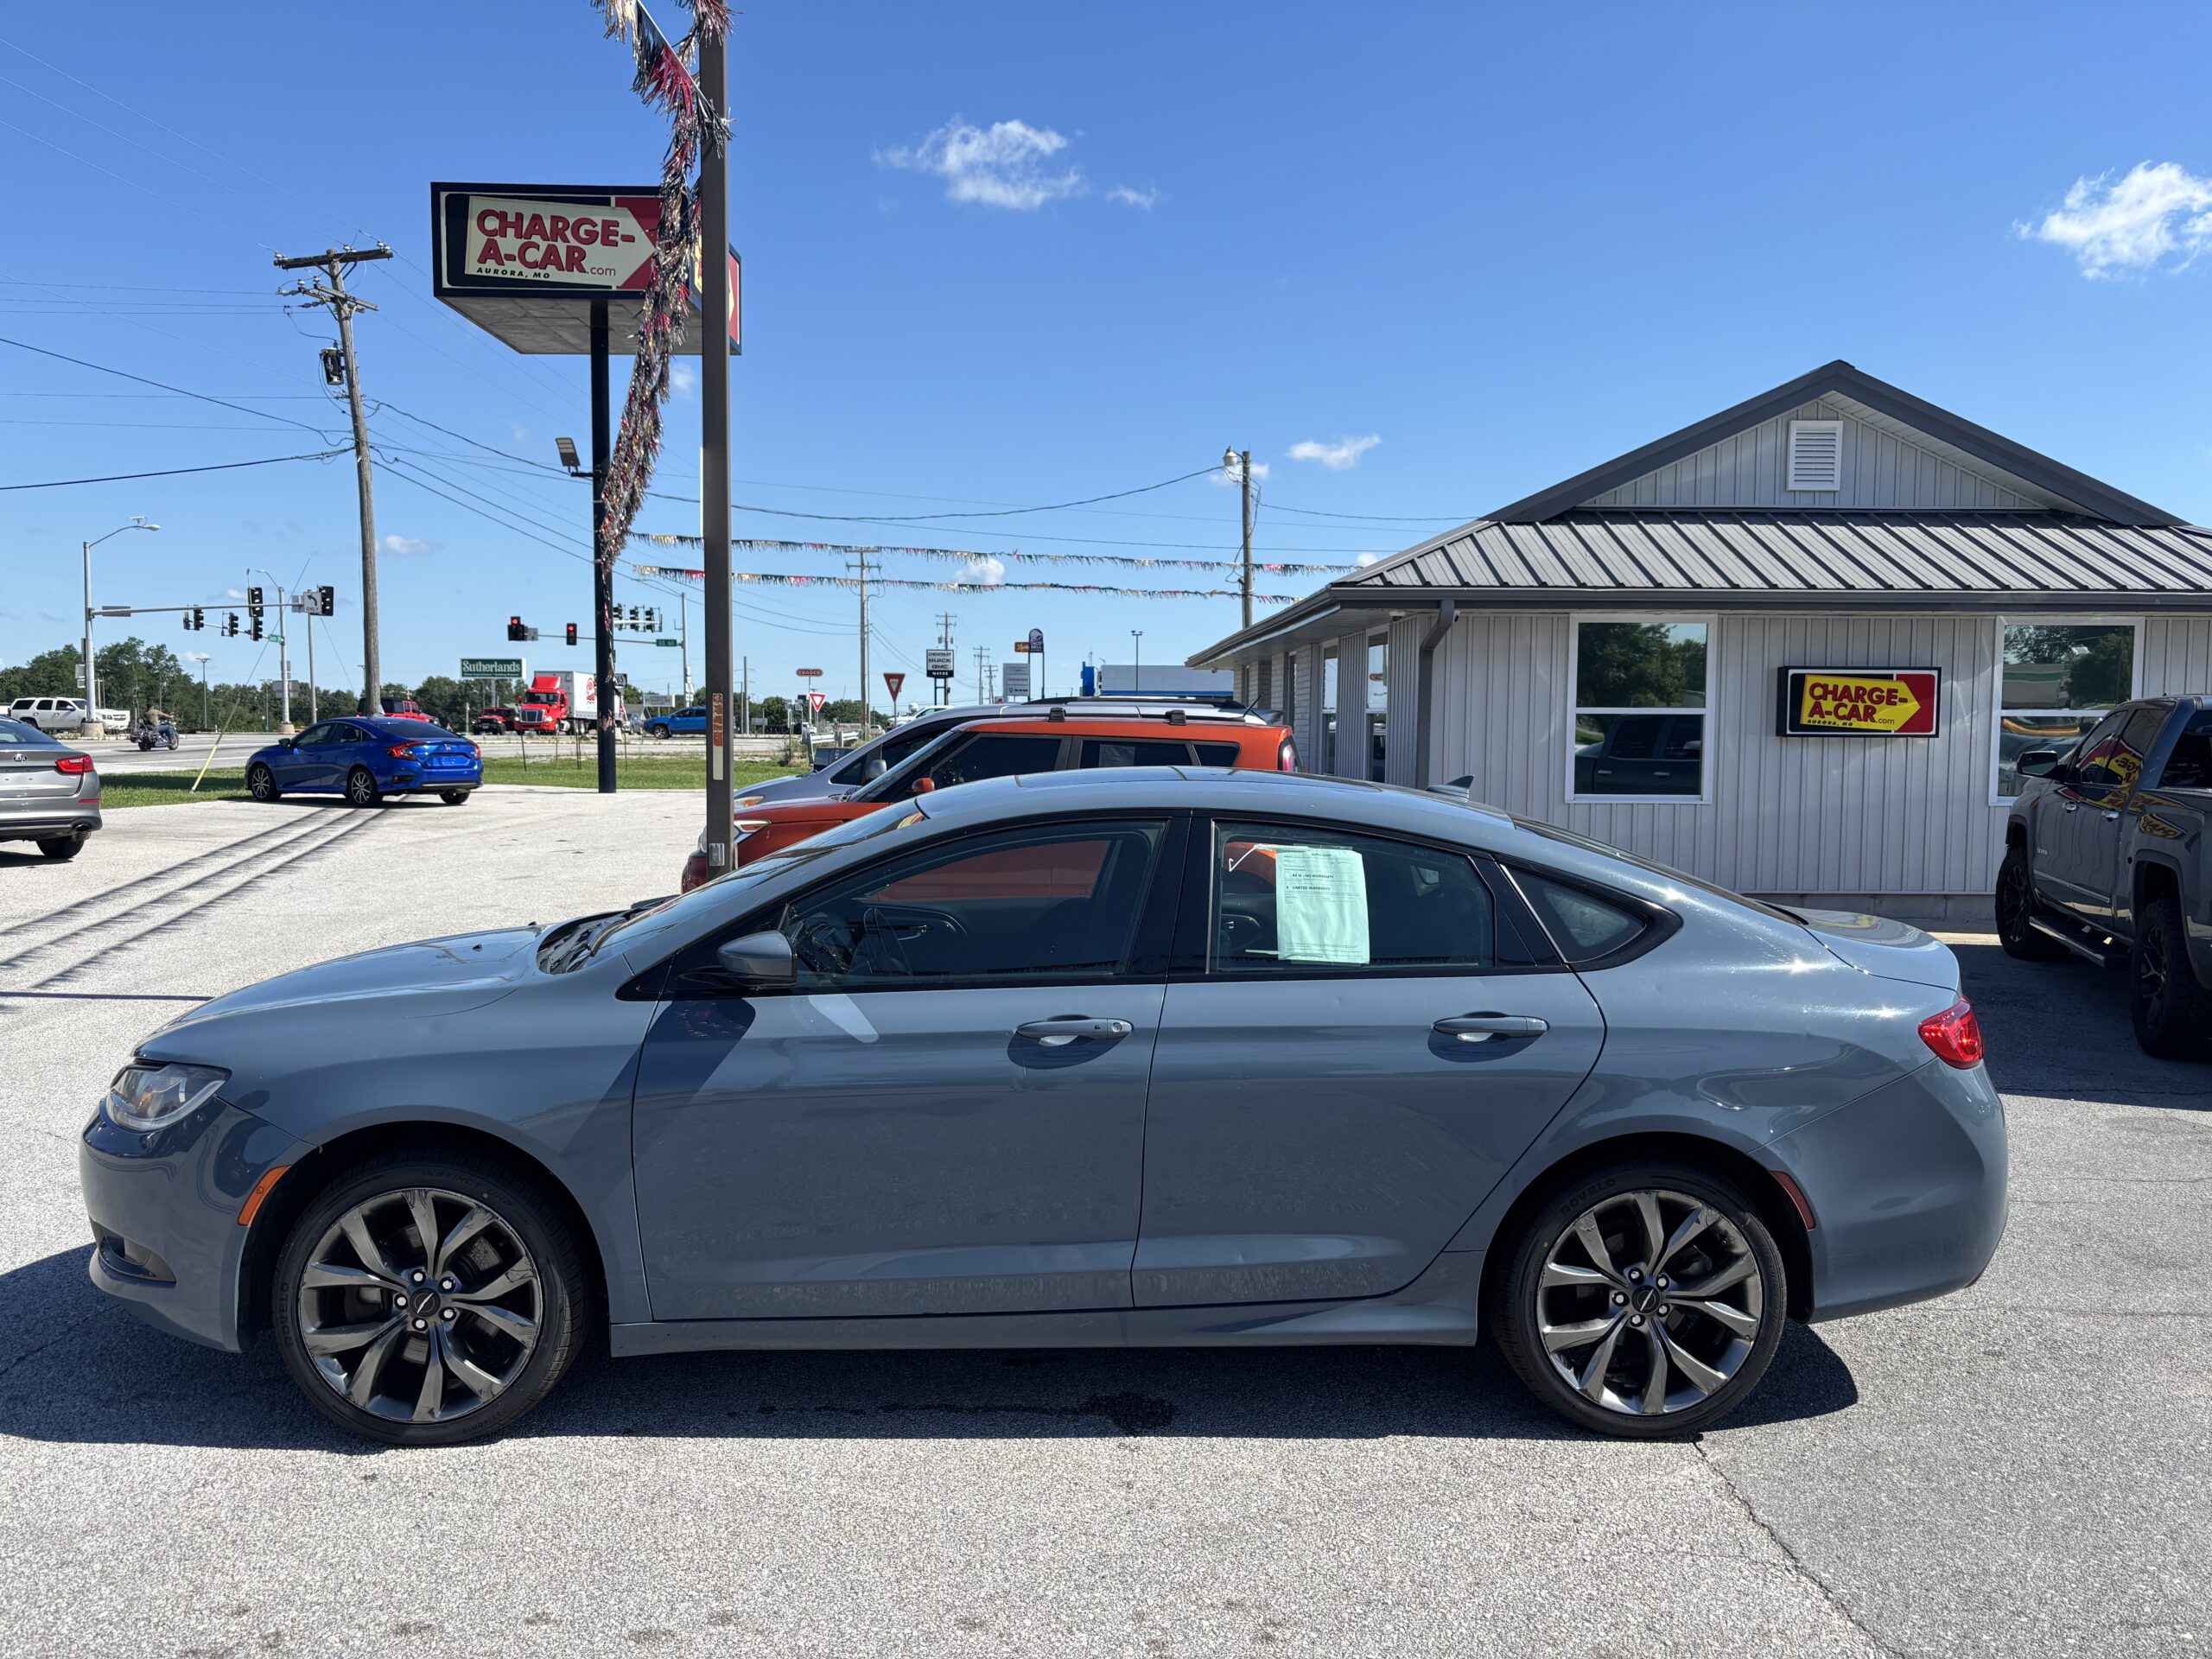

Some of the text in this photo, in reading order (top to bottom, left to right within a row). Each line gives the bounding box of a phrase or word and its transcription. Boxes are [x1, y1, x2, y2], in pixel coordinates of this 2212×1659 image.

[476, 209, 635, 247] CHARGE-
[476, 267, 528, 278] AURORA,
[462, 659, 520, 672] Sutherlands
[1809, 683, 1908, 706] CHARGE-
[1560, 1178, 1616, 1216] ROVELO
[279, 1282, 294, 1348] ROVELO
